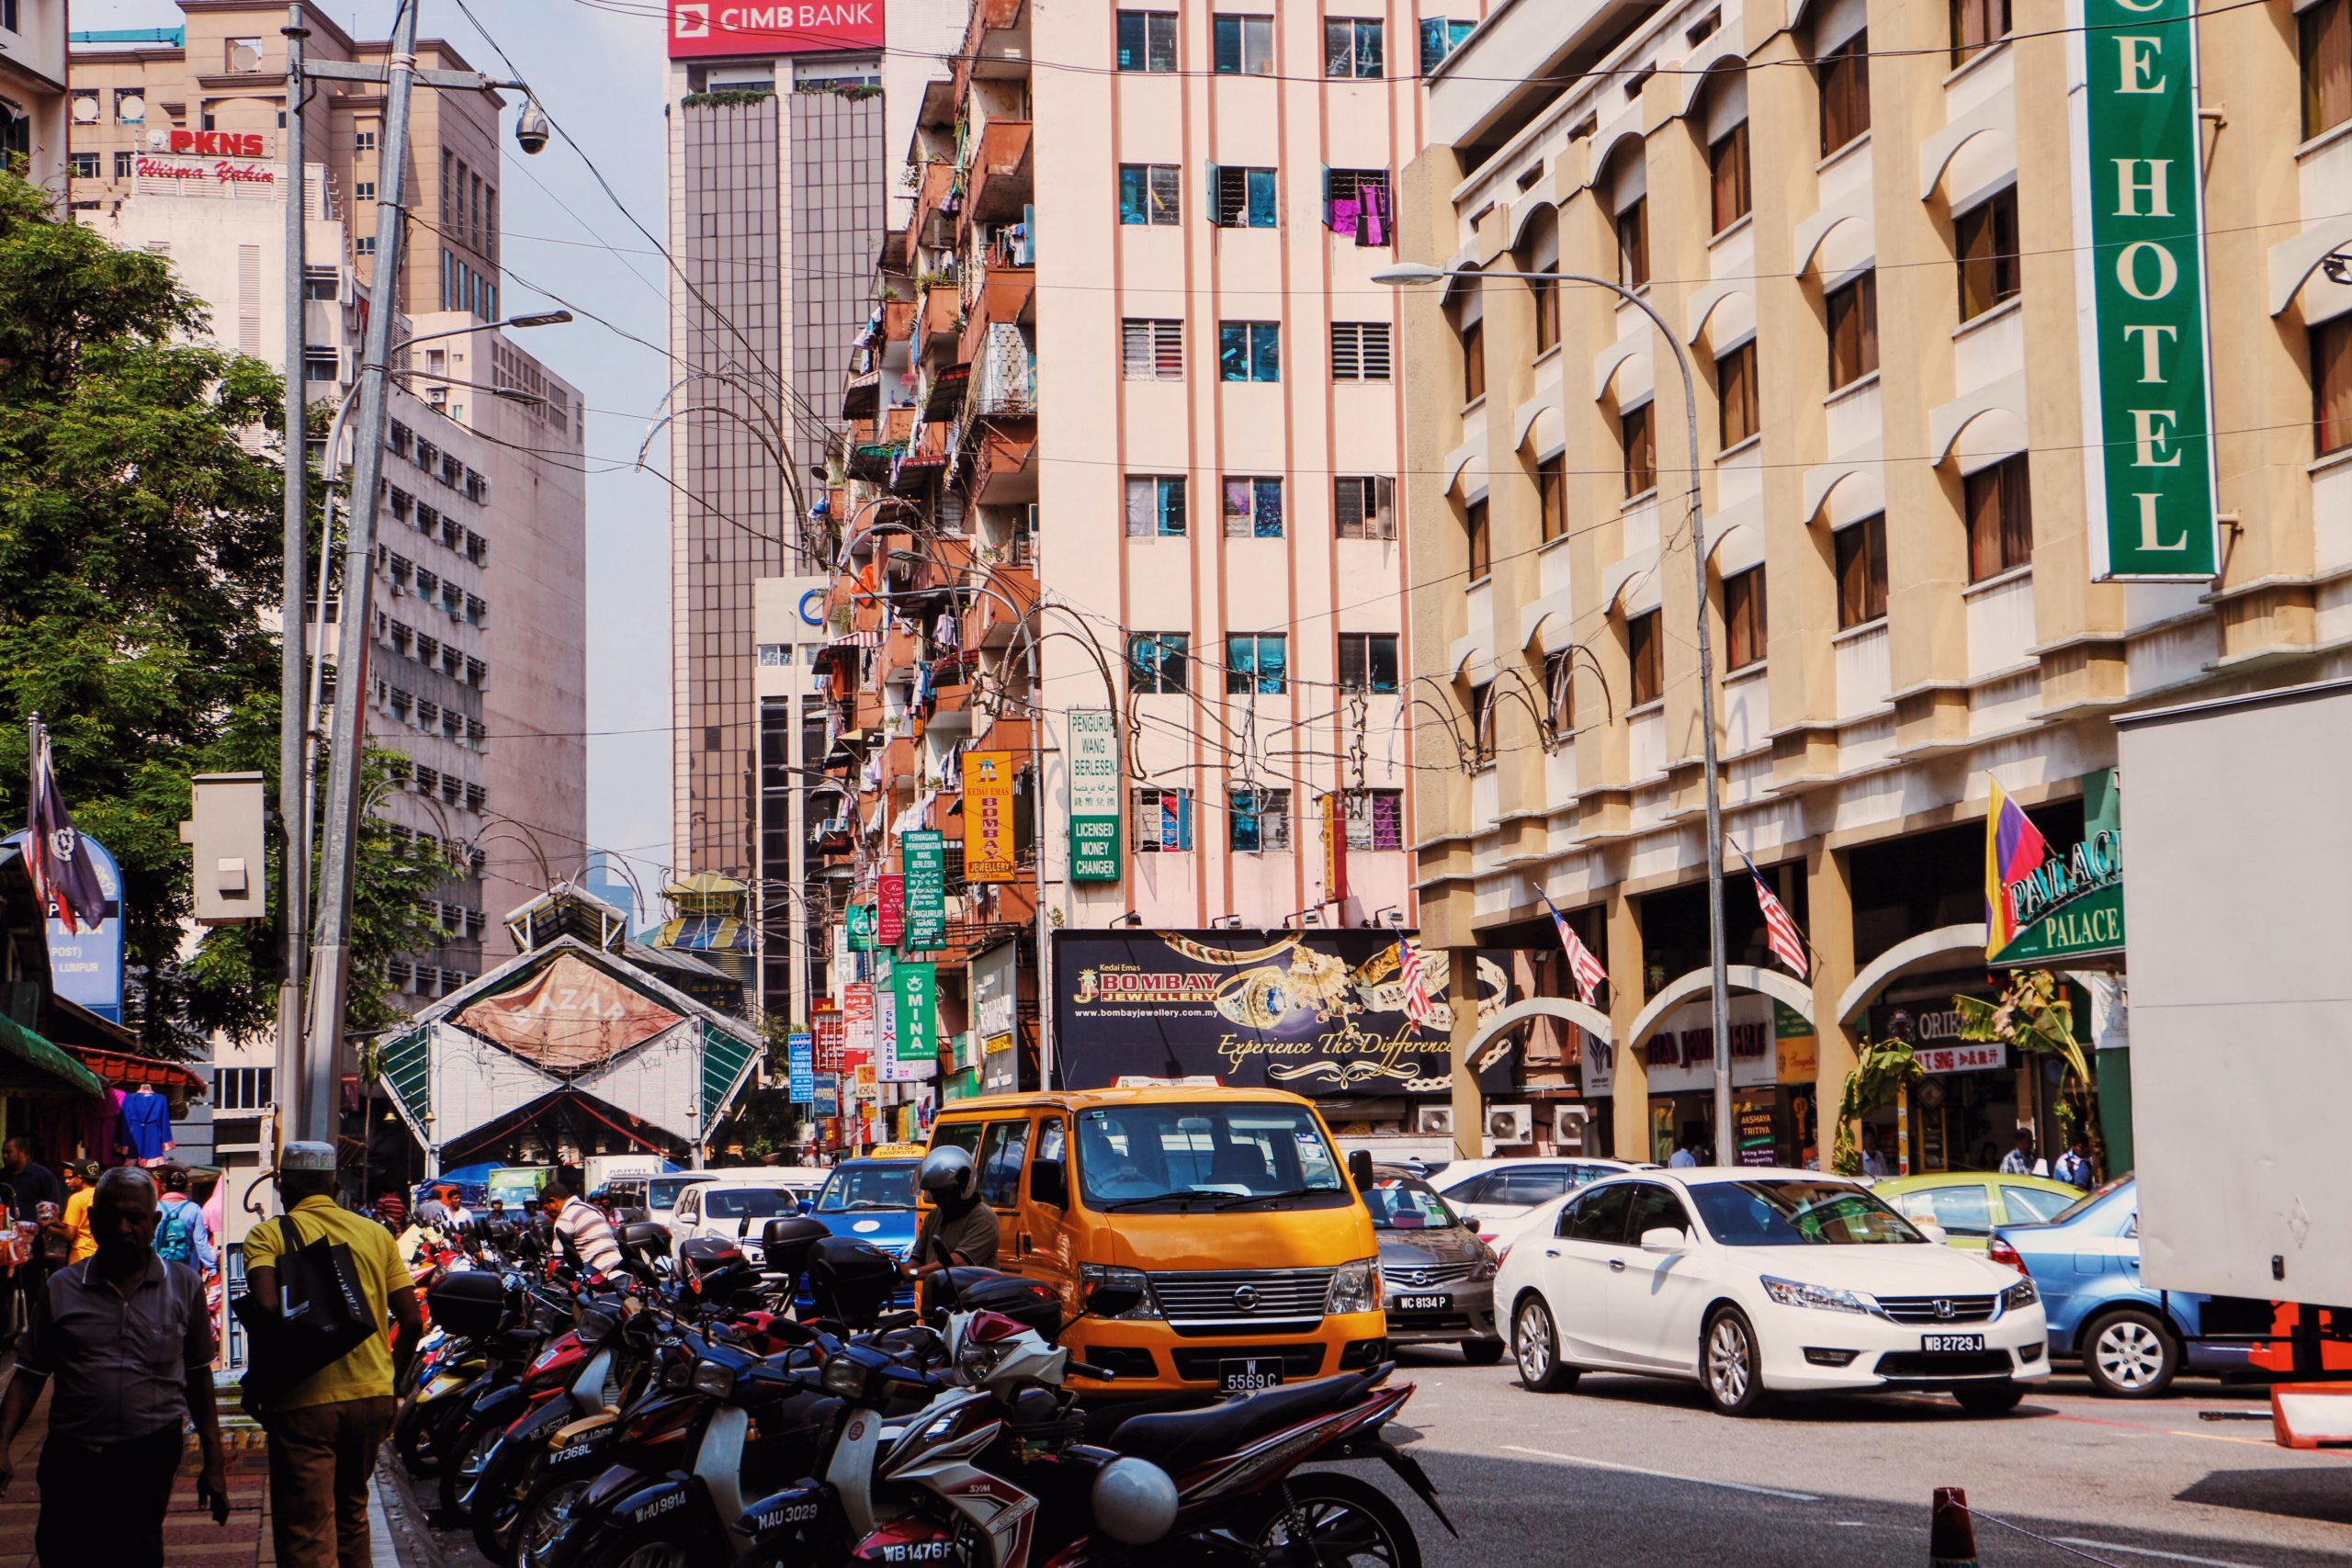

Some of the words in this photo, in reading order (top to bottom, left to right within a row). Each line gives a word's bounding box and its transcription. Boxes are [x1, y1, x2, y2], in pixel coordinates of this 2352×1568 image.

[720, 6, 793, 30] CIMB
[799, 4, 873, 27] BANK
[171, 130, 263, 155] PKNS
[137, 158, 203, 178] Wisma
[2110, 158, 2188, 550] HOTEL
[1072, 716, 1114, 732] PENGURUP
[1081, 738, 1105, 753] WANG
[1074, 760, 1115, 775] BERLESEN
[981, 797, 1000, 860] BOMBAY
[1076, 822, 1114, 837] LICENSED
[1081, 841, 1109, 855] MONEY
[969, 862, 1010, 873] JEWELLERY
[1076, 860, 1114, 874] CHANGER
[2045, 908, 2120, 949] PALACE
[59, 963, 98, 973] LUMPUR
[1100, 974, 1222, 991] BOMBAY
[1102, 992, 1216, 1001] JEWELLERY
[1075, 1009, 1218, 1018] www.bombayjewellery.com.my
[908, 994, 924, 1049] MINA
[1217, 1032, 1314, 1075] Experience
[1317, 1021, 1360, 1055] The
[1934, 1050, 1955, 1070] SING
[1741, 1114, 1770, 1124] AKSHAYA
[1743, 1126, 1770, 1135] TRITIYA
[1401, 1298, 1414, 1308] WC
[1416, 1297, 1438, 1308] 8134
[1440, 1297, 1447, 1308] P
[1925, 1337, 1941, 1351] WB
[1943, 1336, 1973, 1351] 2729
[1974, 1335, 1983, 1351] J
[1247, 1360, 1257, 1374] W
[1227, 1374, 1265, 1389] 5569
[1268, 1373, 1276, 1387] C
[969, 1484, 991, 1493] SYM
[785, 1503, 818, 1522] 3029
